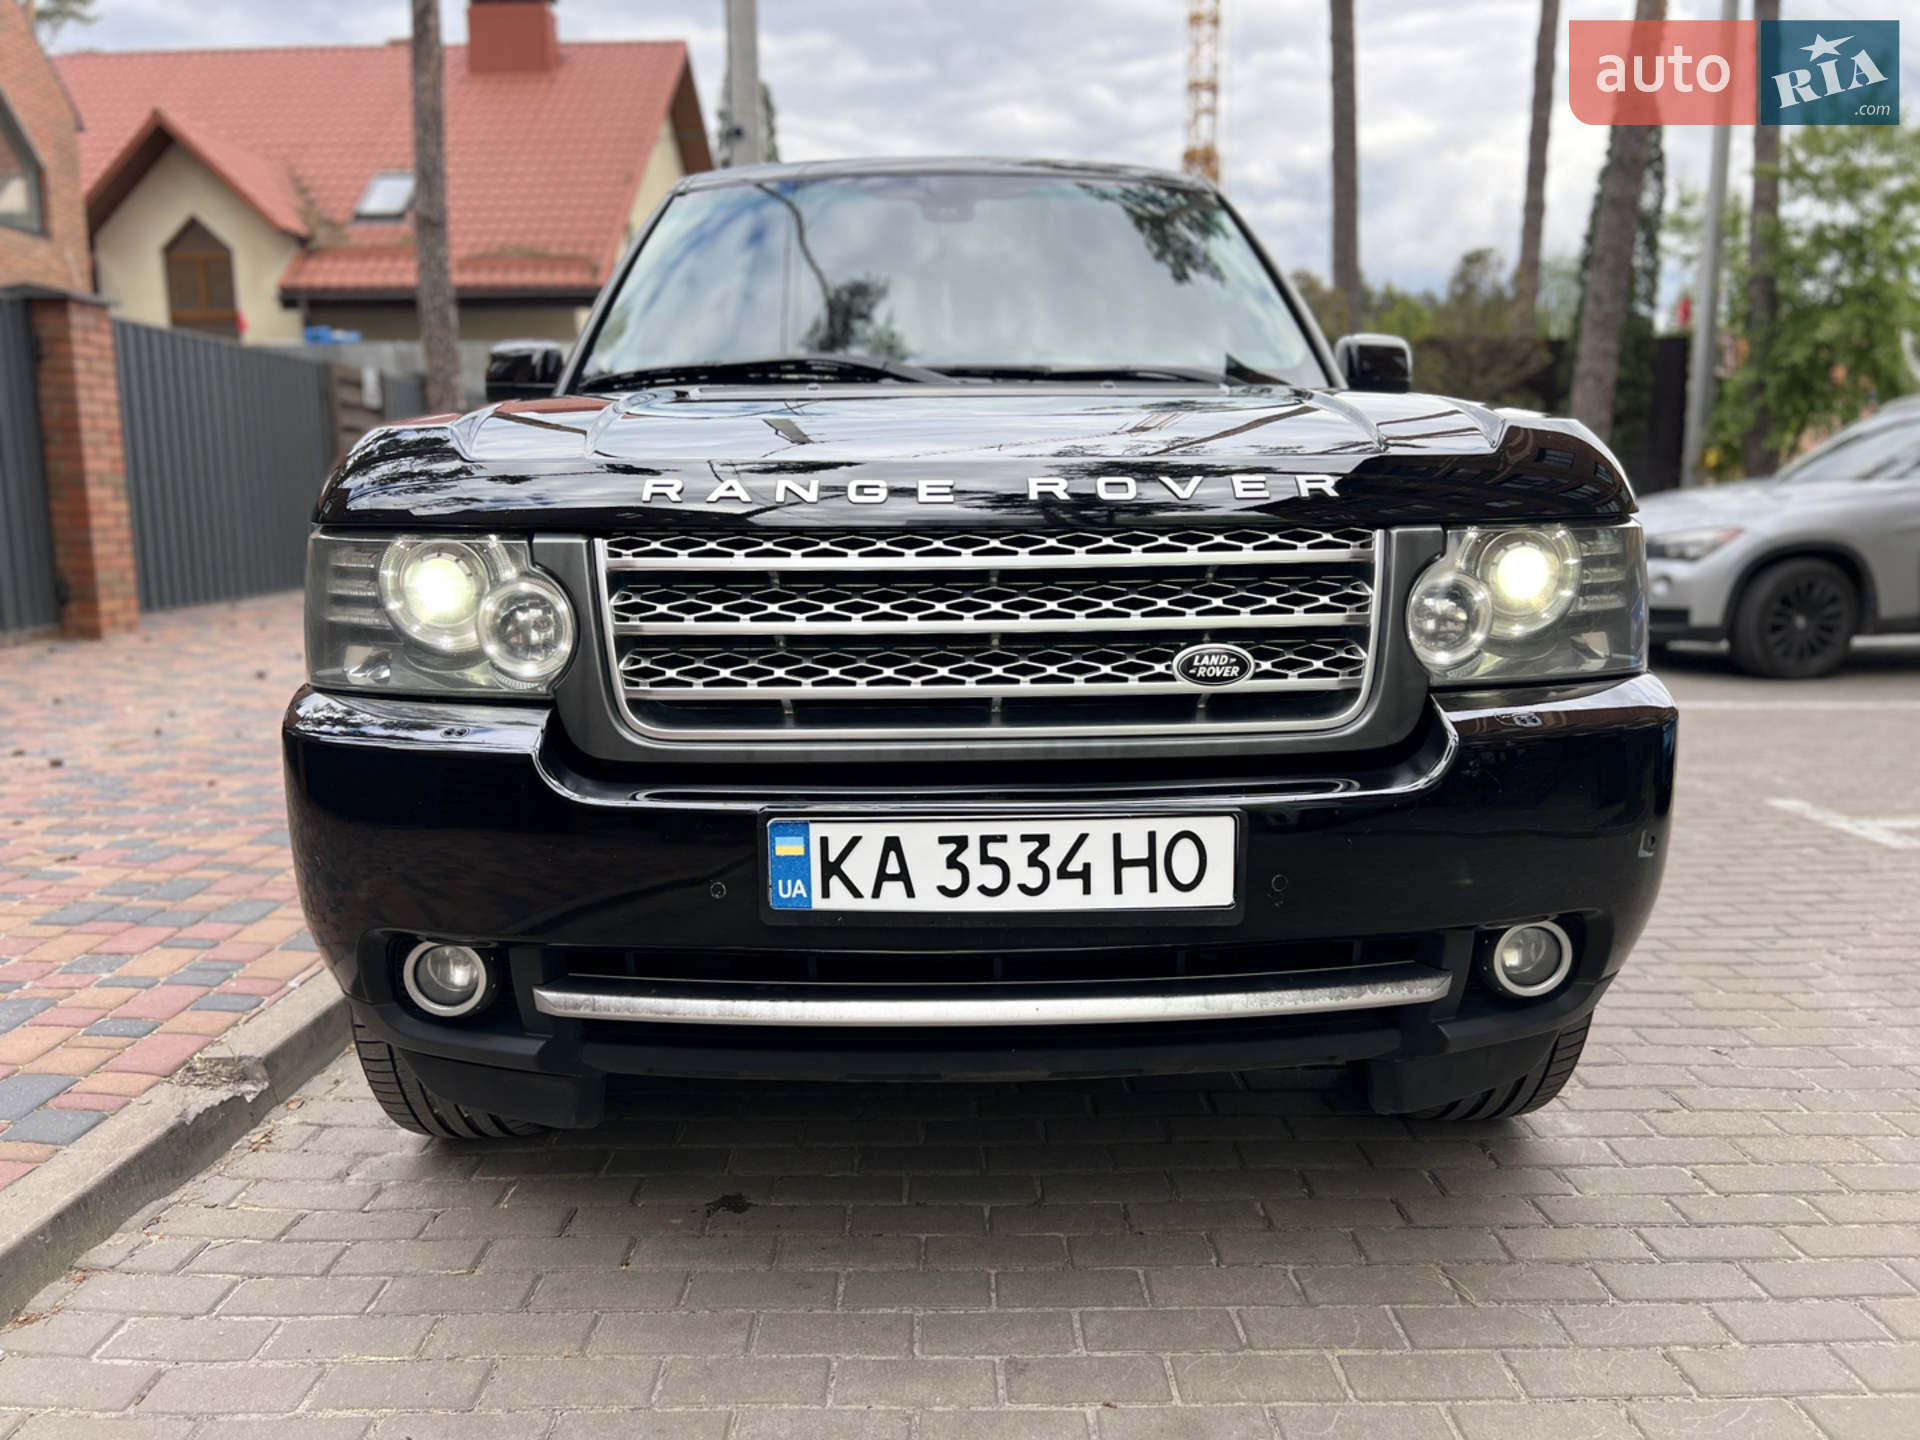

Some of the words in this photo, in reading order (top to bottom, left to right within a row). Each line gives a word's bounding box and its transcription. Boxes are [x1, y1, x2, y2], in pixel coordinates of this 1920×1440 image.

[641, 479, 955, 503] RANGE
[1027, 475, 1340, 500] ROVER
[819, 835, 916, 899] KA
[936, 833, 1091, 898] 3534
[1112, 830, 1207, 895] HO
[778, 880, 807, 898] UA
